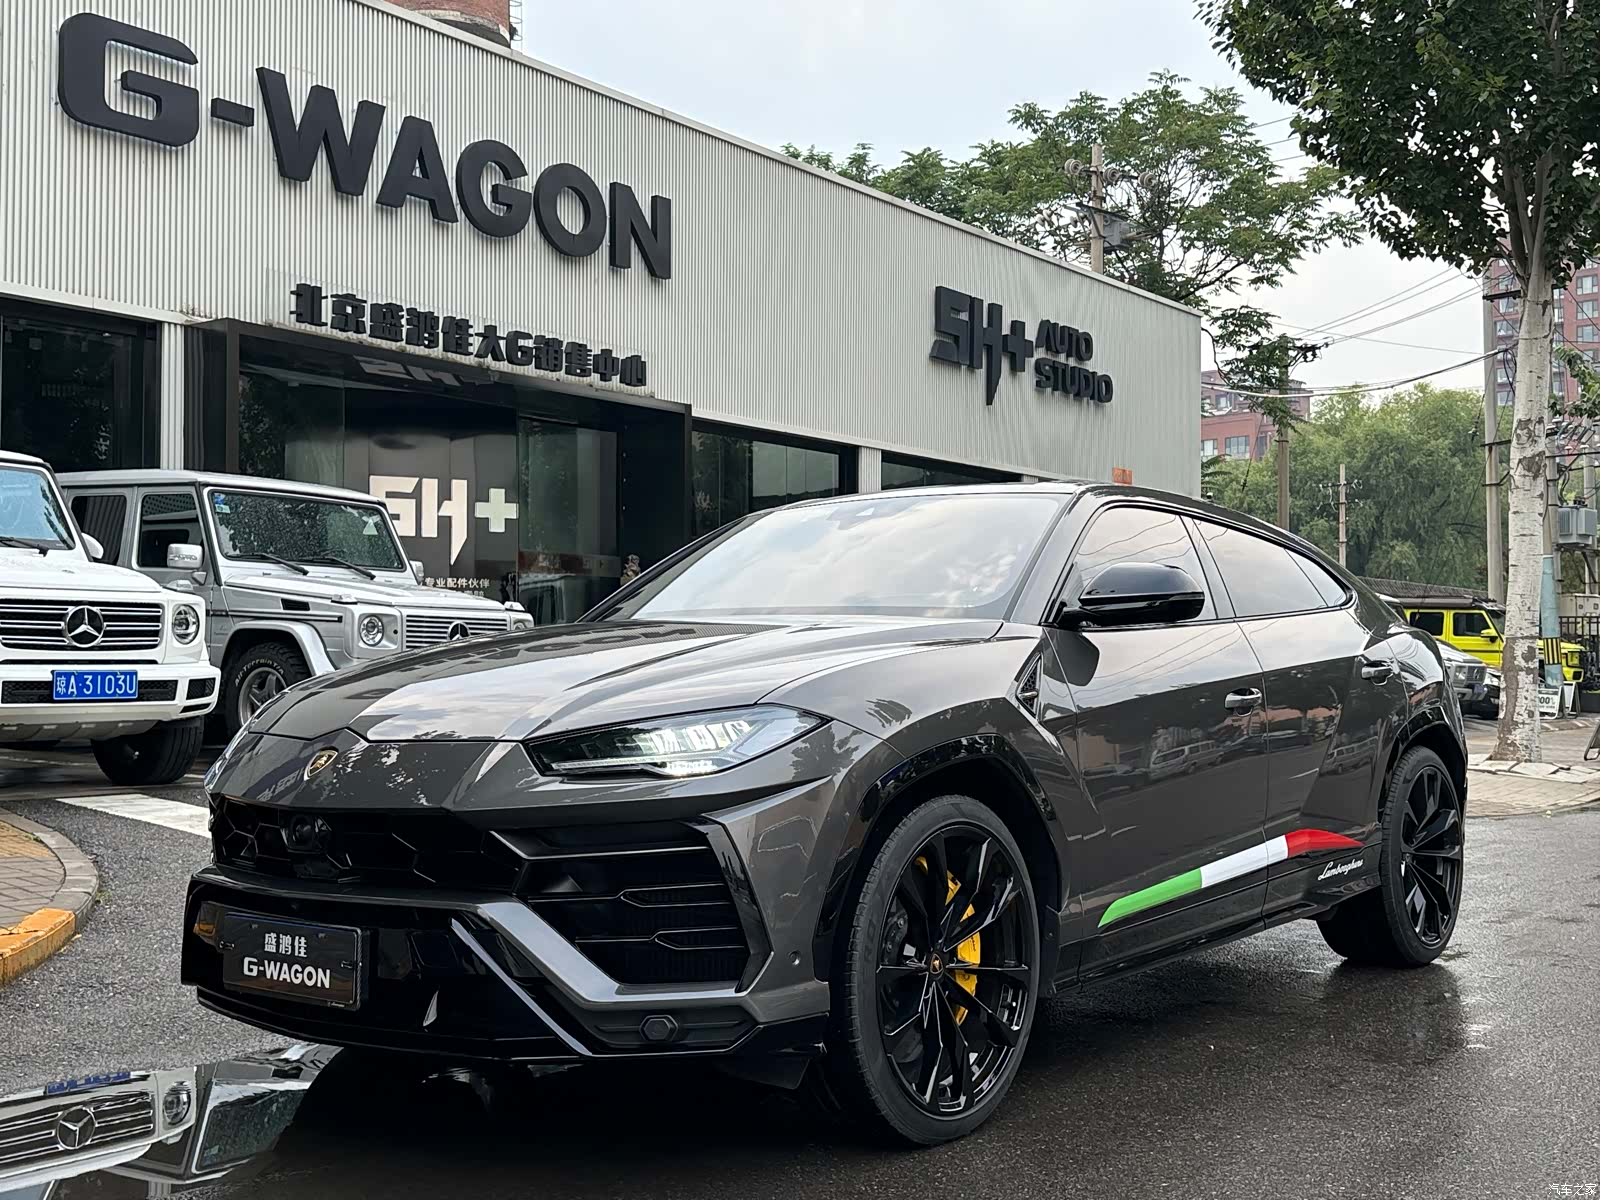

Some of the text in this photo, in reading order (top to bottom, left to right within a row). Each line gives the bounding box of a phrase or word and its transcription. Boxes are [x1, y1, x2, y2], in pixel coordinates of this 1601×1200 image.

[58, 12, 671, 279] G-WAGON
[290, 283, 647, 387] 北京盛鸿佳大G销售中心
[1035, 319, 1093, 361] AUTO
[1035, 358, 1113, 403] STUDIO
[1317, 859, 1364, 880] Lamborghini
[264, 932, 308, 957] 盛鸿佳
[243, 957, 331, 988] G-WAGON
